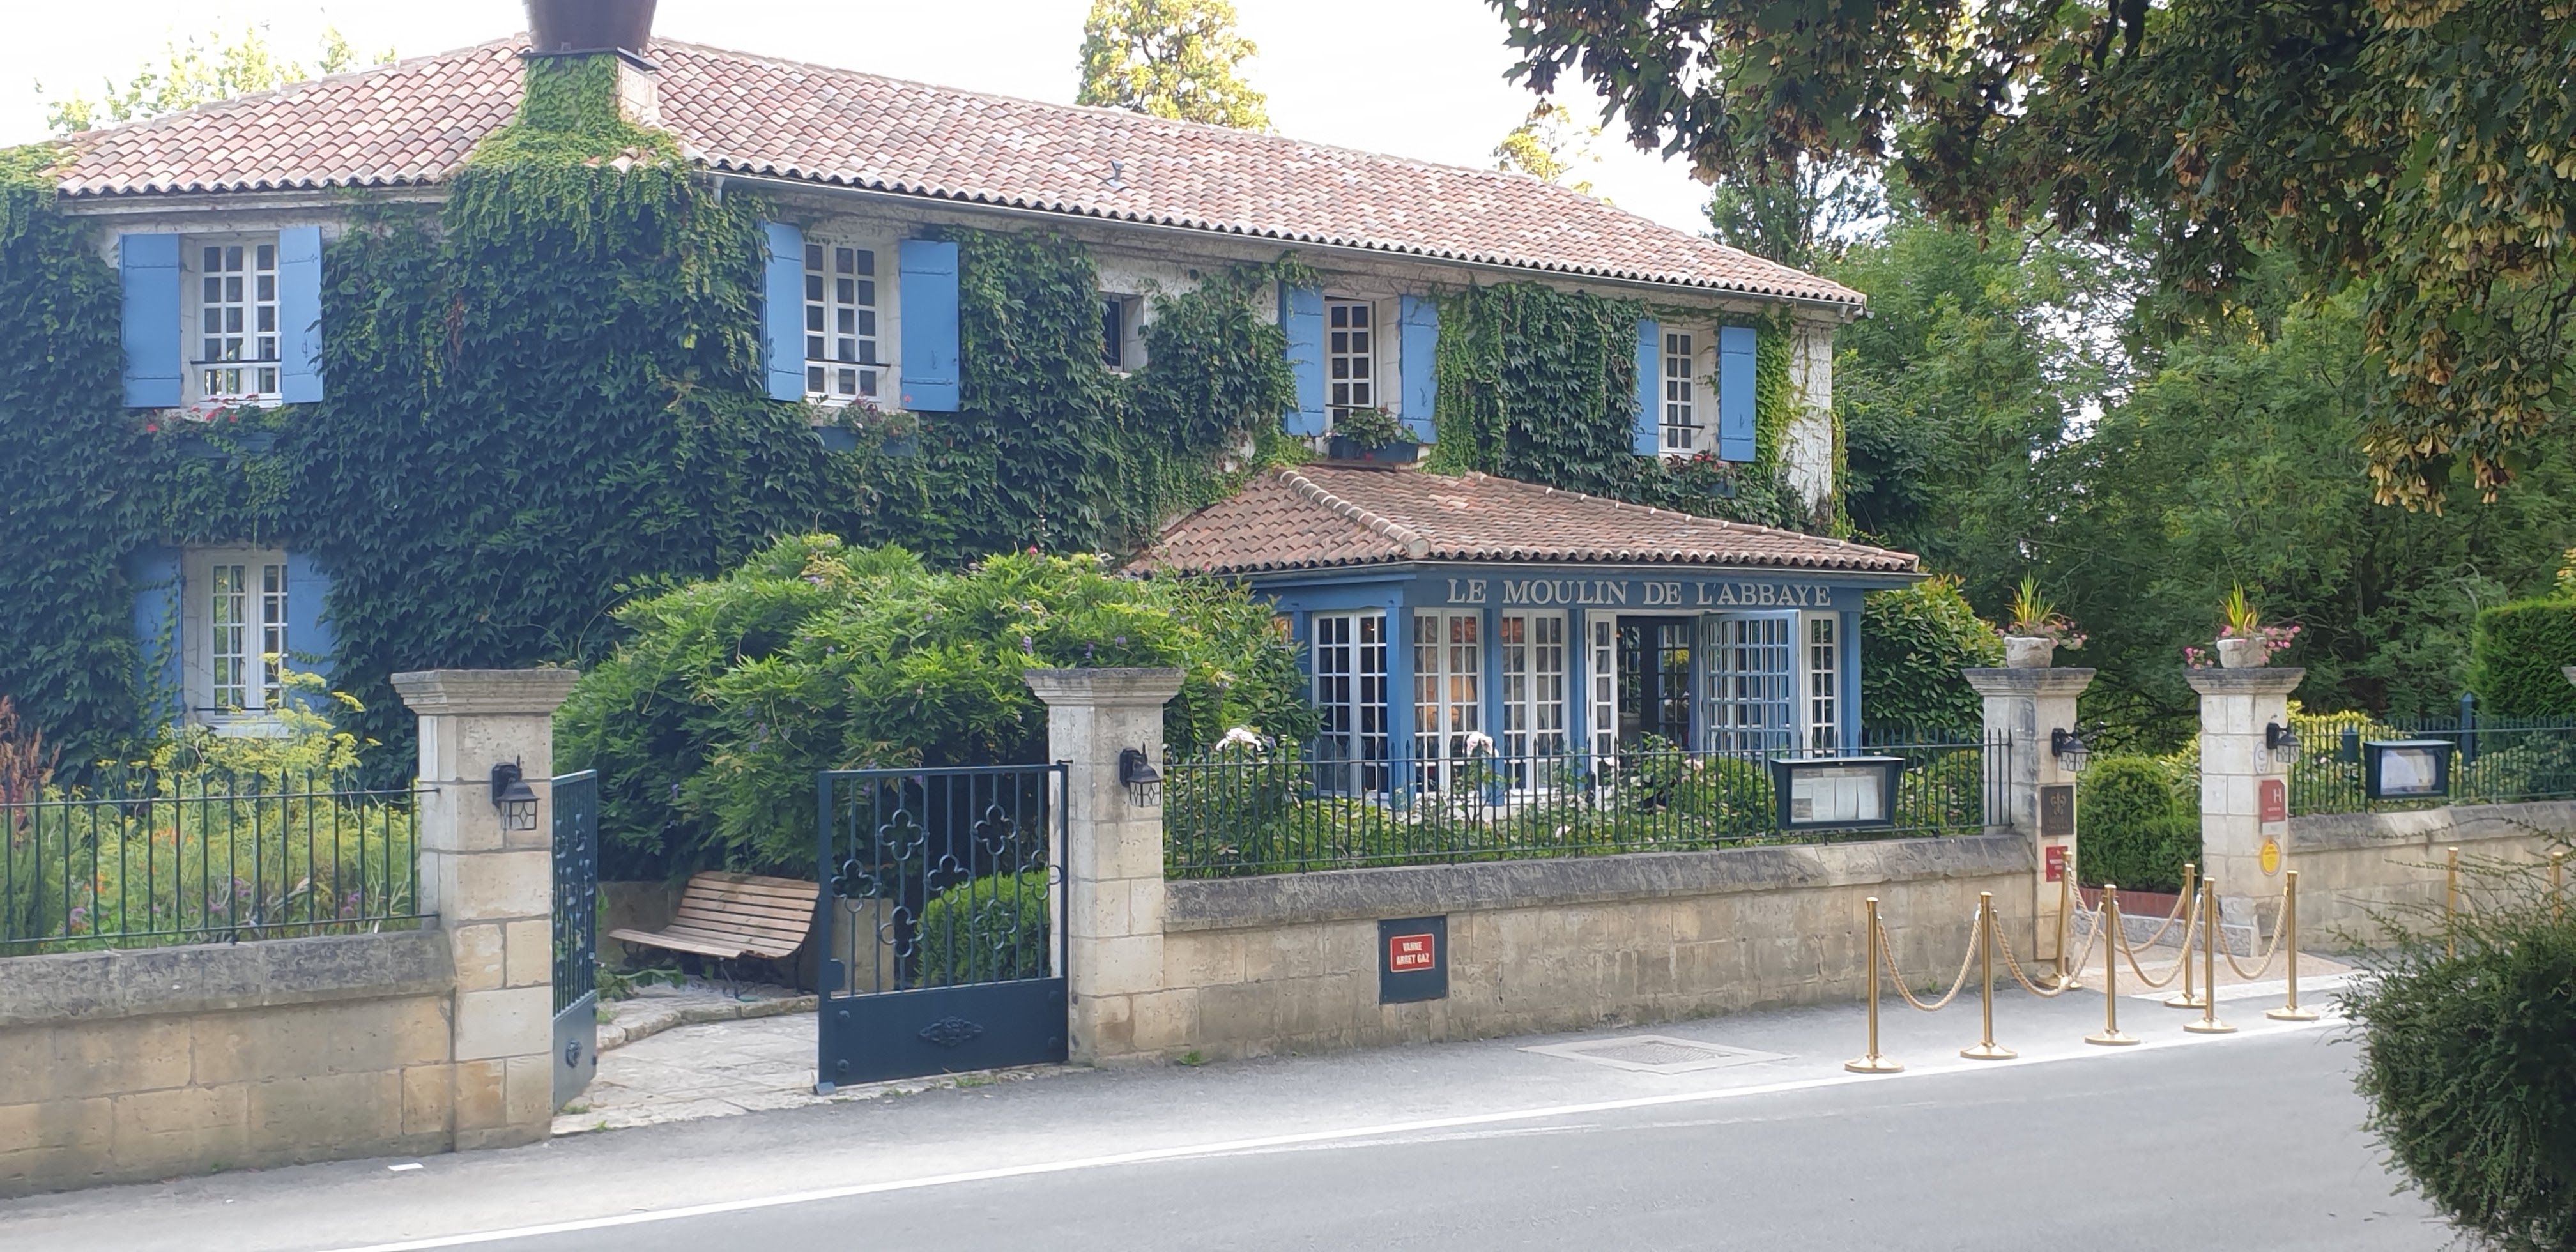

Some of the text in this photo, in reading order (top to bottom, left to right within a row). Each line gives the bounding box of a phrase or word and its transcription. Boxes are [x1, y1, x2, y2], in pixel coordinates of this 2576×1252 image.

[1446, 578, 1831, 606] LE MOULIN DE L'ABBAYE
[2273, 788, 2281, 803] H
[1416, 953, 1430, 963] GAZ
